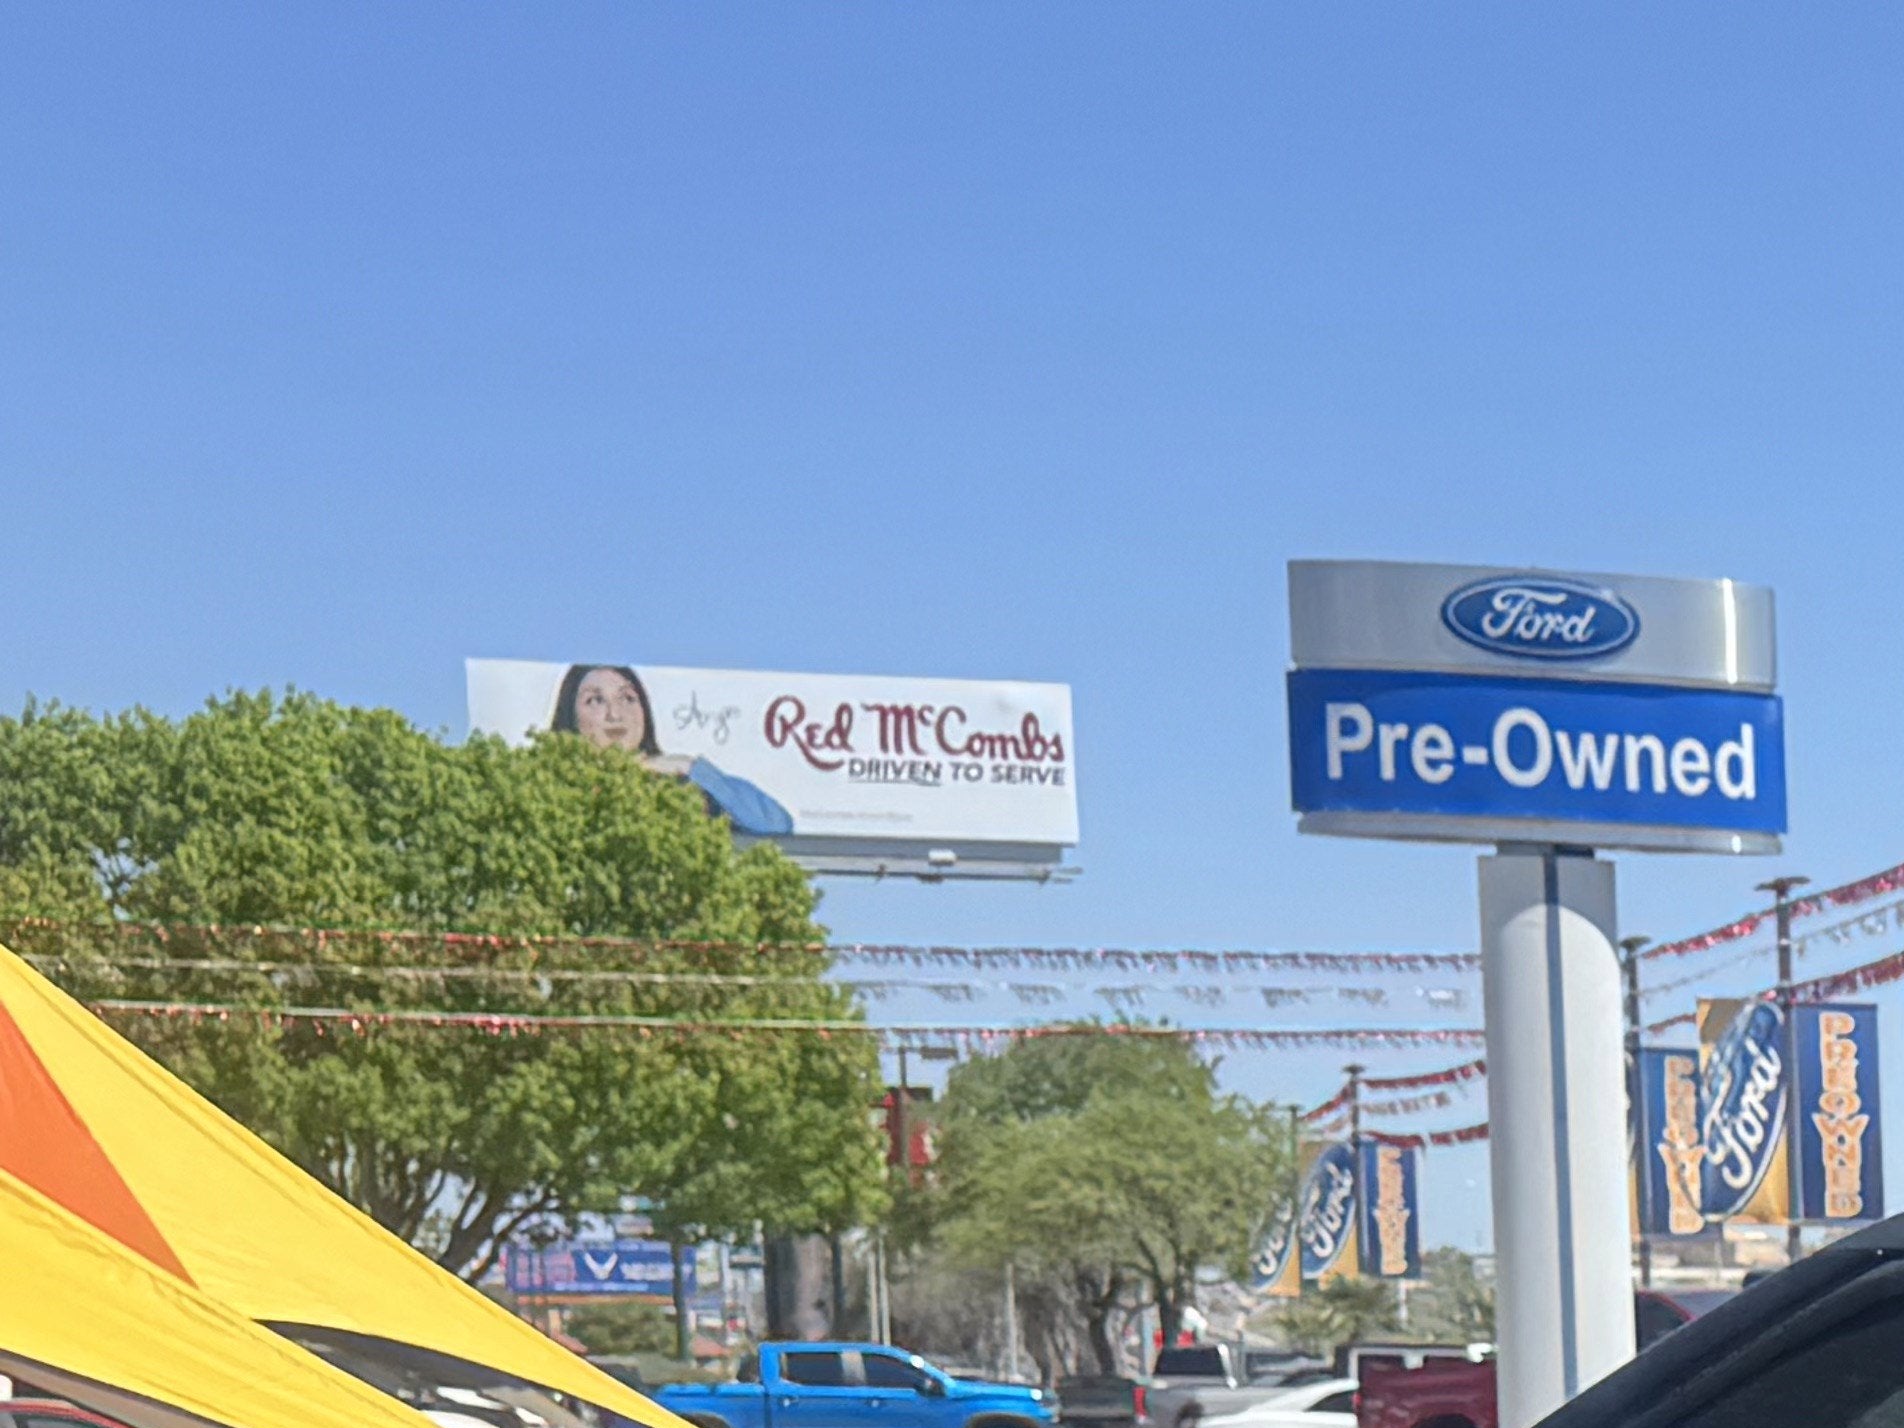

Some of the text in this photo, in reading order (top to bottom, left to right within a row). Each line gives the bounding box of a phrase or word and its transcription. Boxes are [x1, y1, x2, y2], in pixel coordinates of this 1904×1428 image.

[1481, 588, 1597, 642] Ford
[764, 694, 854, 771] Red
[861, 702, 1065, 763] McCombs
[1324, 702, 1757, 800] Pre-Owned
[849, 758, 1066, 786] DRIVEN TO SERVE
[1703, 1037, 1782, 1190] Ford
